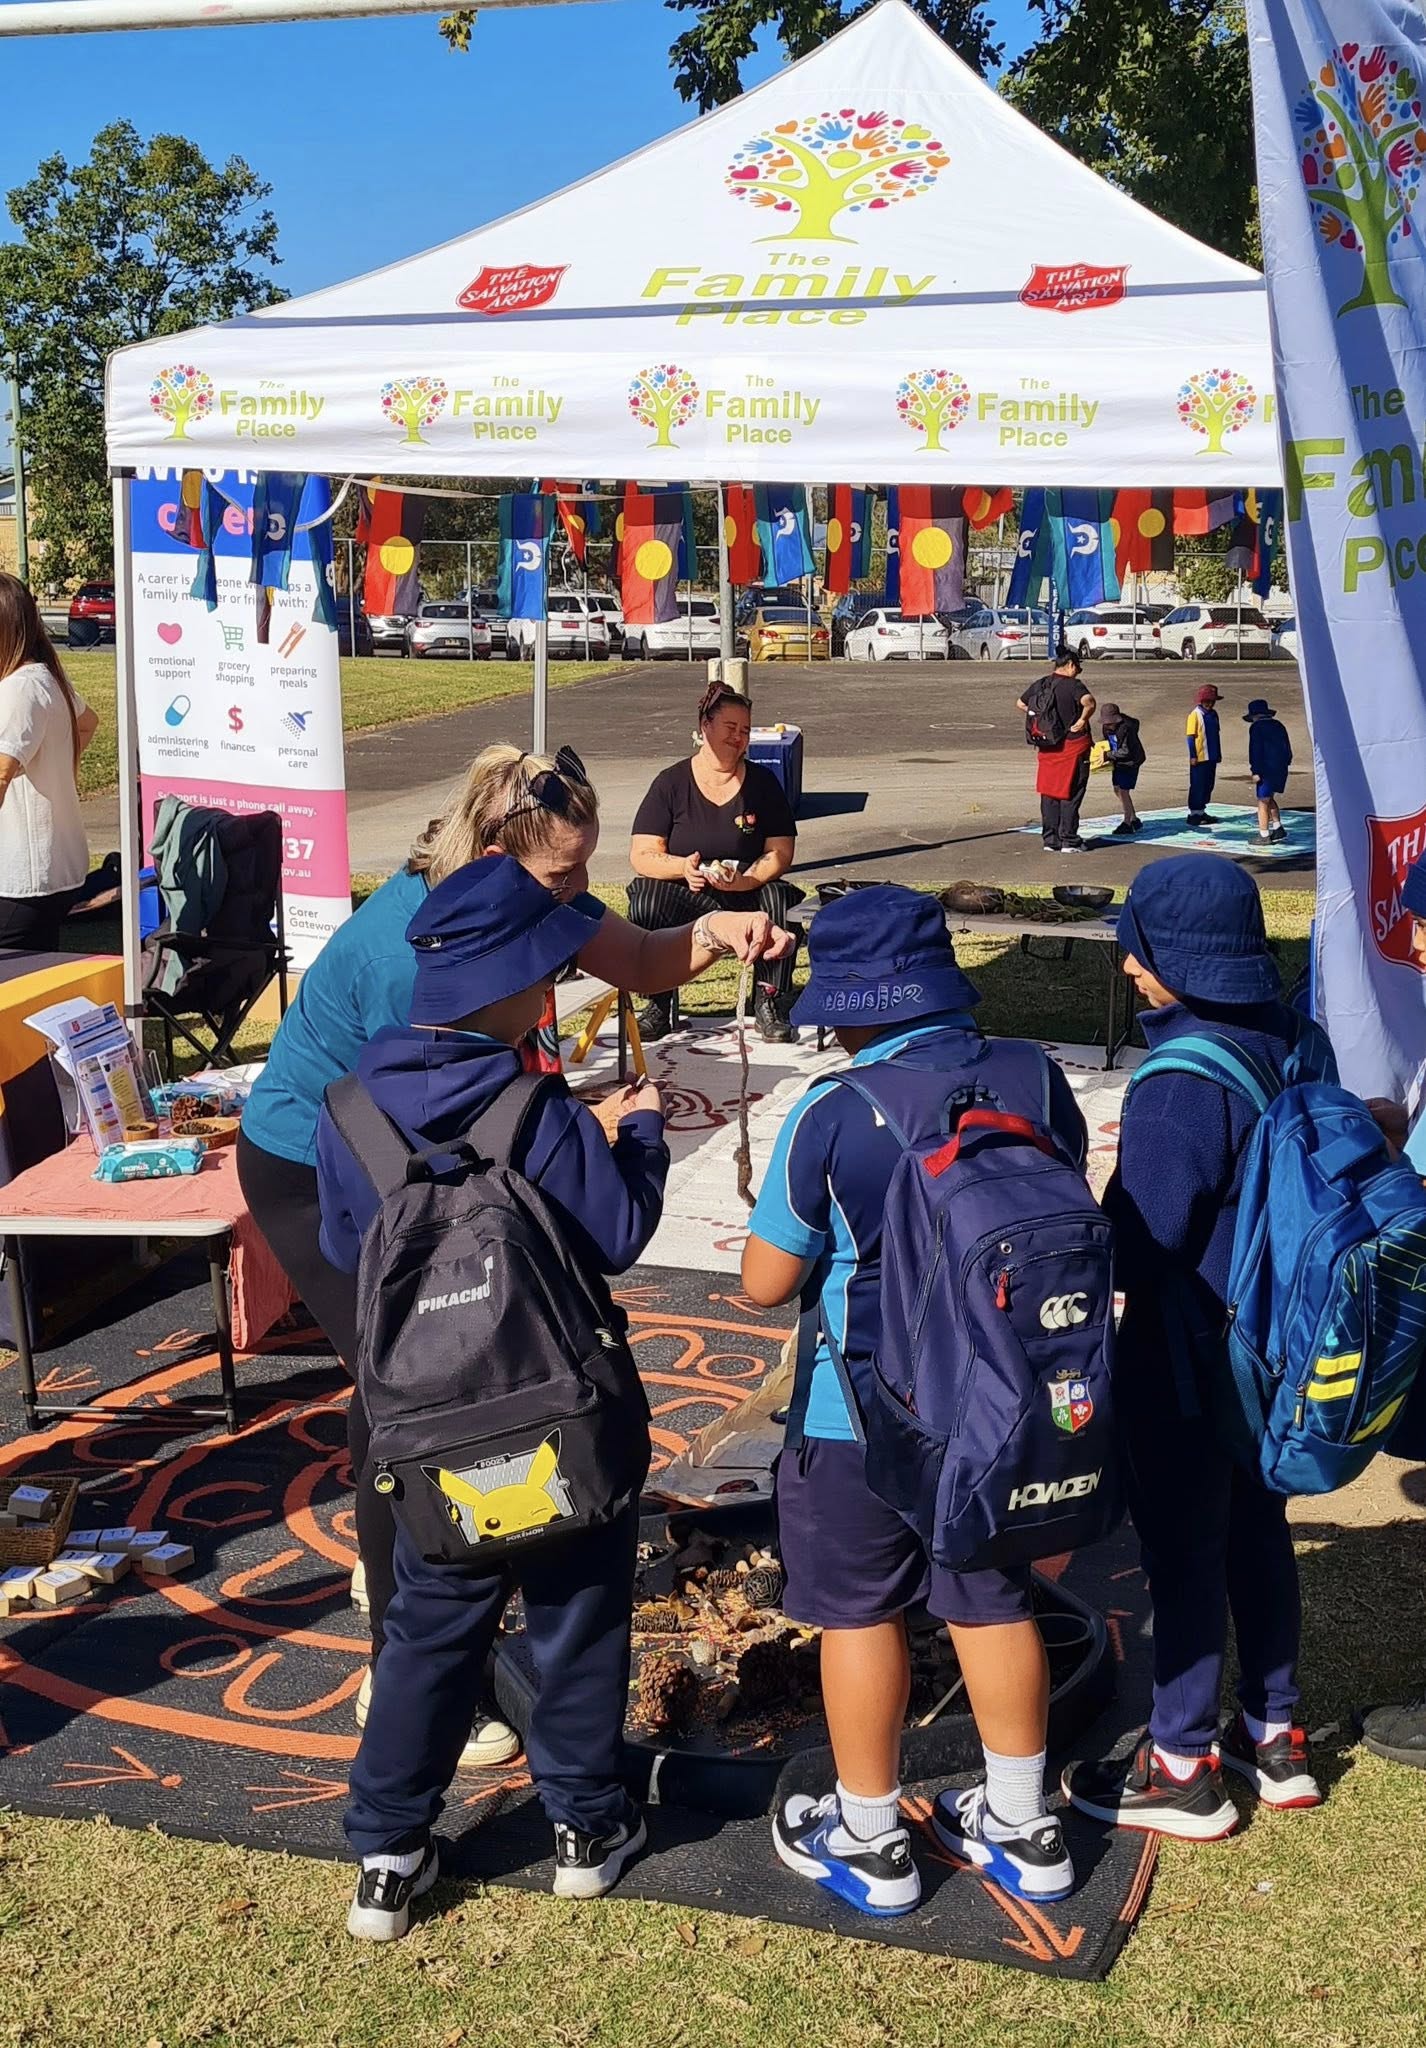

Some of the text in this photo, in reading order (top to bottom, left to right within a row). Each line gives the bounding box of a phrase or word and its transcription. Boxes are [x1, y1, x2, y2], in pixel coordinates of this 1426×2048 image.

[768, 253, 831, 265] The
[488, 266, 529, 286] THE
[1046, 266, 1087, 284] THE
[461, 270, 559, 304] SALVATION
[640, 266, 937, 305] Family
[1024, 270, 1121, 301] SALVATION
[485, 285, 548, 309] ARMY
[1055, 285, 1114, 308] ARMY
[675, 303, 868, 325] Place
[259, 381, 285, 389] The
[493, 376, 520, 387] The
[746, 375, 774, 387] The
[1019, 377, 1050, 389] The
[219, 390, 325, 421] Family
[453, 390, 564, 423] Family
[705, 390, 822, 426] Family
[977, 392, 1100, 429] Family
[236, 419, 296, 437] Place
[473, 421, 537, 440] Place
[726, 423, 793, 443] Place
[999, 426, 1068, 447] Place
[1286, 426, 1426, 522] Fam
[138, 572, 145, 583] A
[148, 574, 178, 585] carer
[181, 574, 190, 585] is
[142, 587, 179, 603] family
[230, 595, 242, 604] or
[278, 597, 309, 609] with:
[148, 656, 196, 667] emotional
[218, 661, 251, 673] grocery
[154, 668, 191, 680] support
[215, 672, 255, 687] shopping
[270, 666, 318, 679] preparing
[279, 678, 308, 689] meals
[148, 735, 209, 750] administering
[220, 740, 256, 753] finances
[158, 748, 200, 759] medicine
[278, 746, 319, 758] personal
[288, 759, 308, 768] care
[200, 794, 208, 804] is
[209, 796, 228, 808] just
[229, 799, 235, 807] a
[237, 799, 266, 813] phone
[268, 803, 286, 813] call
[287, 804, 318, 818] away.
[281, 837, 316, 861] 37
[1387, 823, 1426, 876] TH
[288, 906, 319, 919] Carer
[289, 917, 338, 933] Gateway
[417, 1273, 492, 1315] PIKACHU
[1007, 1466, 1103, 1511] HOWDEN
